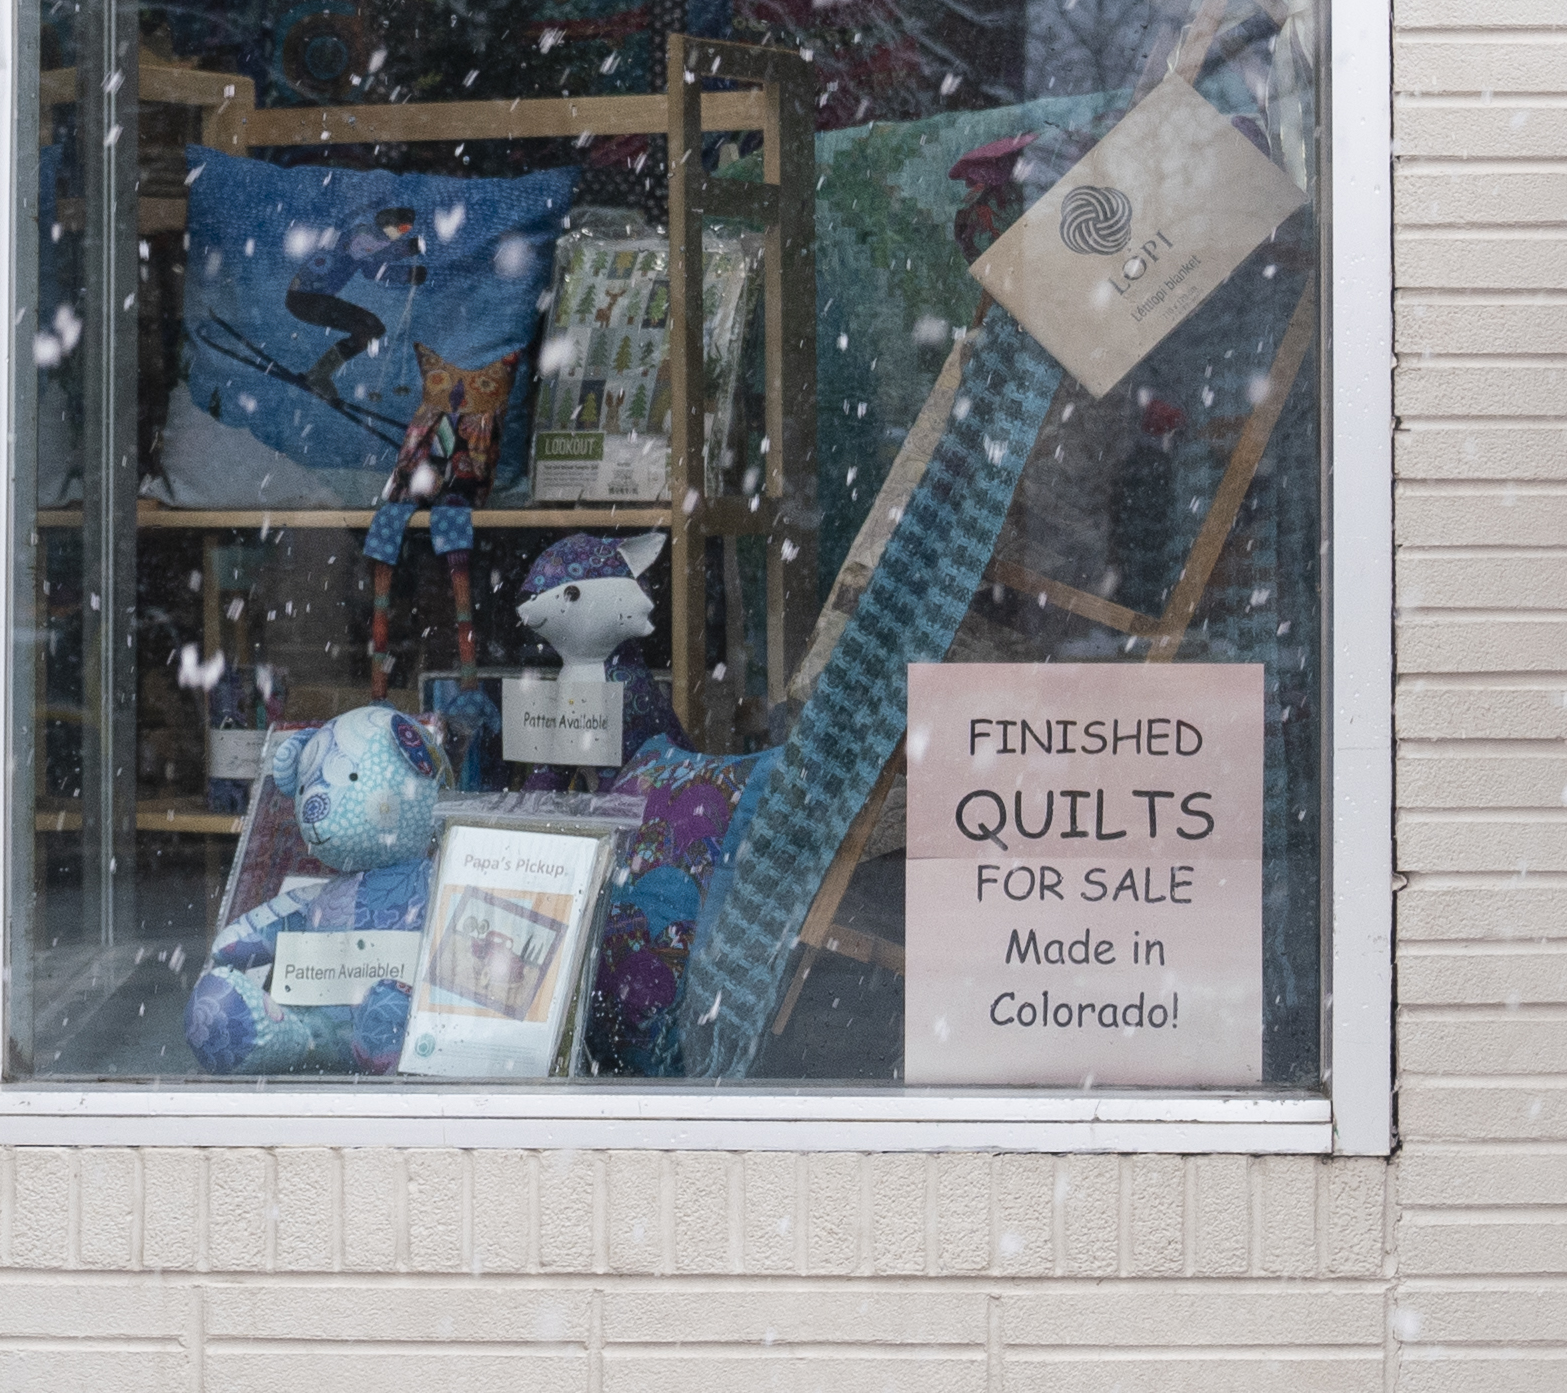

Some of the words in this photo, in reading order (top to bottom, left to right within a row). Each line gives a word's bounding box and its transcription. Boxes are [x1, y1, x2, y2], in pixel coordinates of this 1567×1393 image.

[1164, 255, 1202, 291] blanket
[545, 438, 596, 455] LOOKOUT
[970, 718, 1203, 756] FINISHED
[955, 788, 1215, 851] QUILTS
[463, 854, 512, 873] Papa's
[977, 864, 1064, 903] FOR
[1080, 866, 1195, 904] SALE
[1005, 928, 1116, 966] Made
[1132, 930, 1165, 966] in
[284, 964, 336, 980] Pattern
[337, 962, 405, 980] Available!
[989, 990, 1179, 1029] Colorado!
